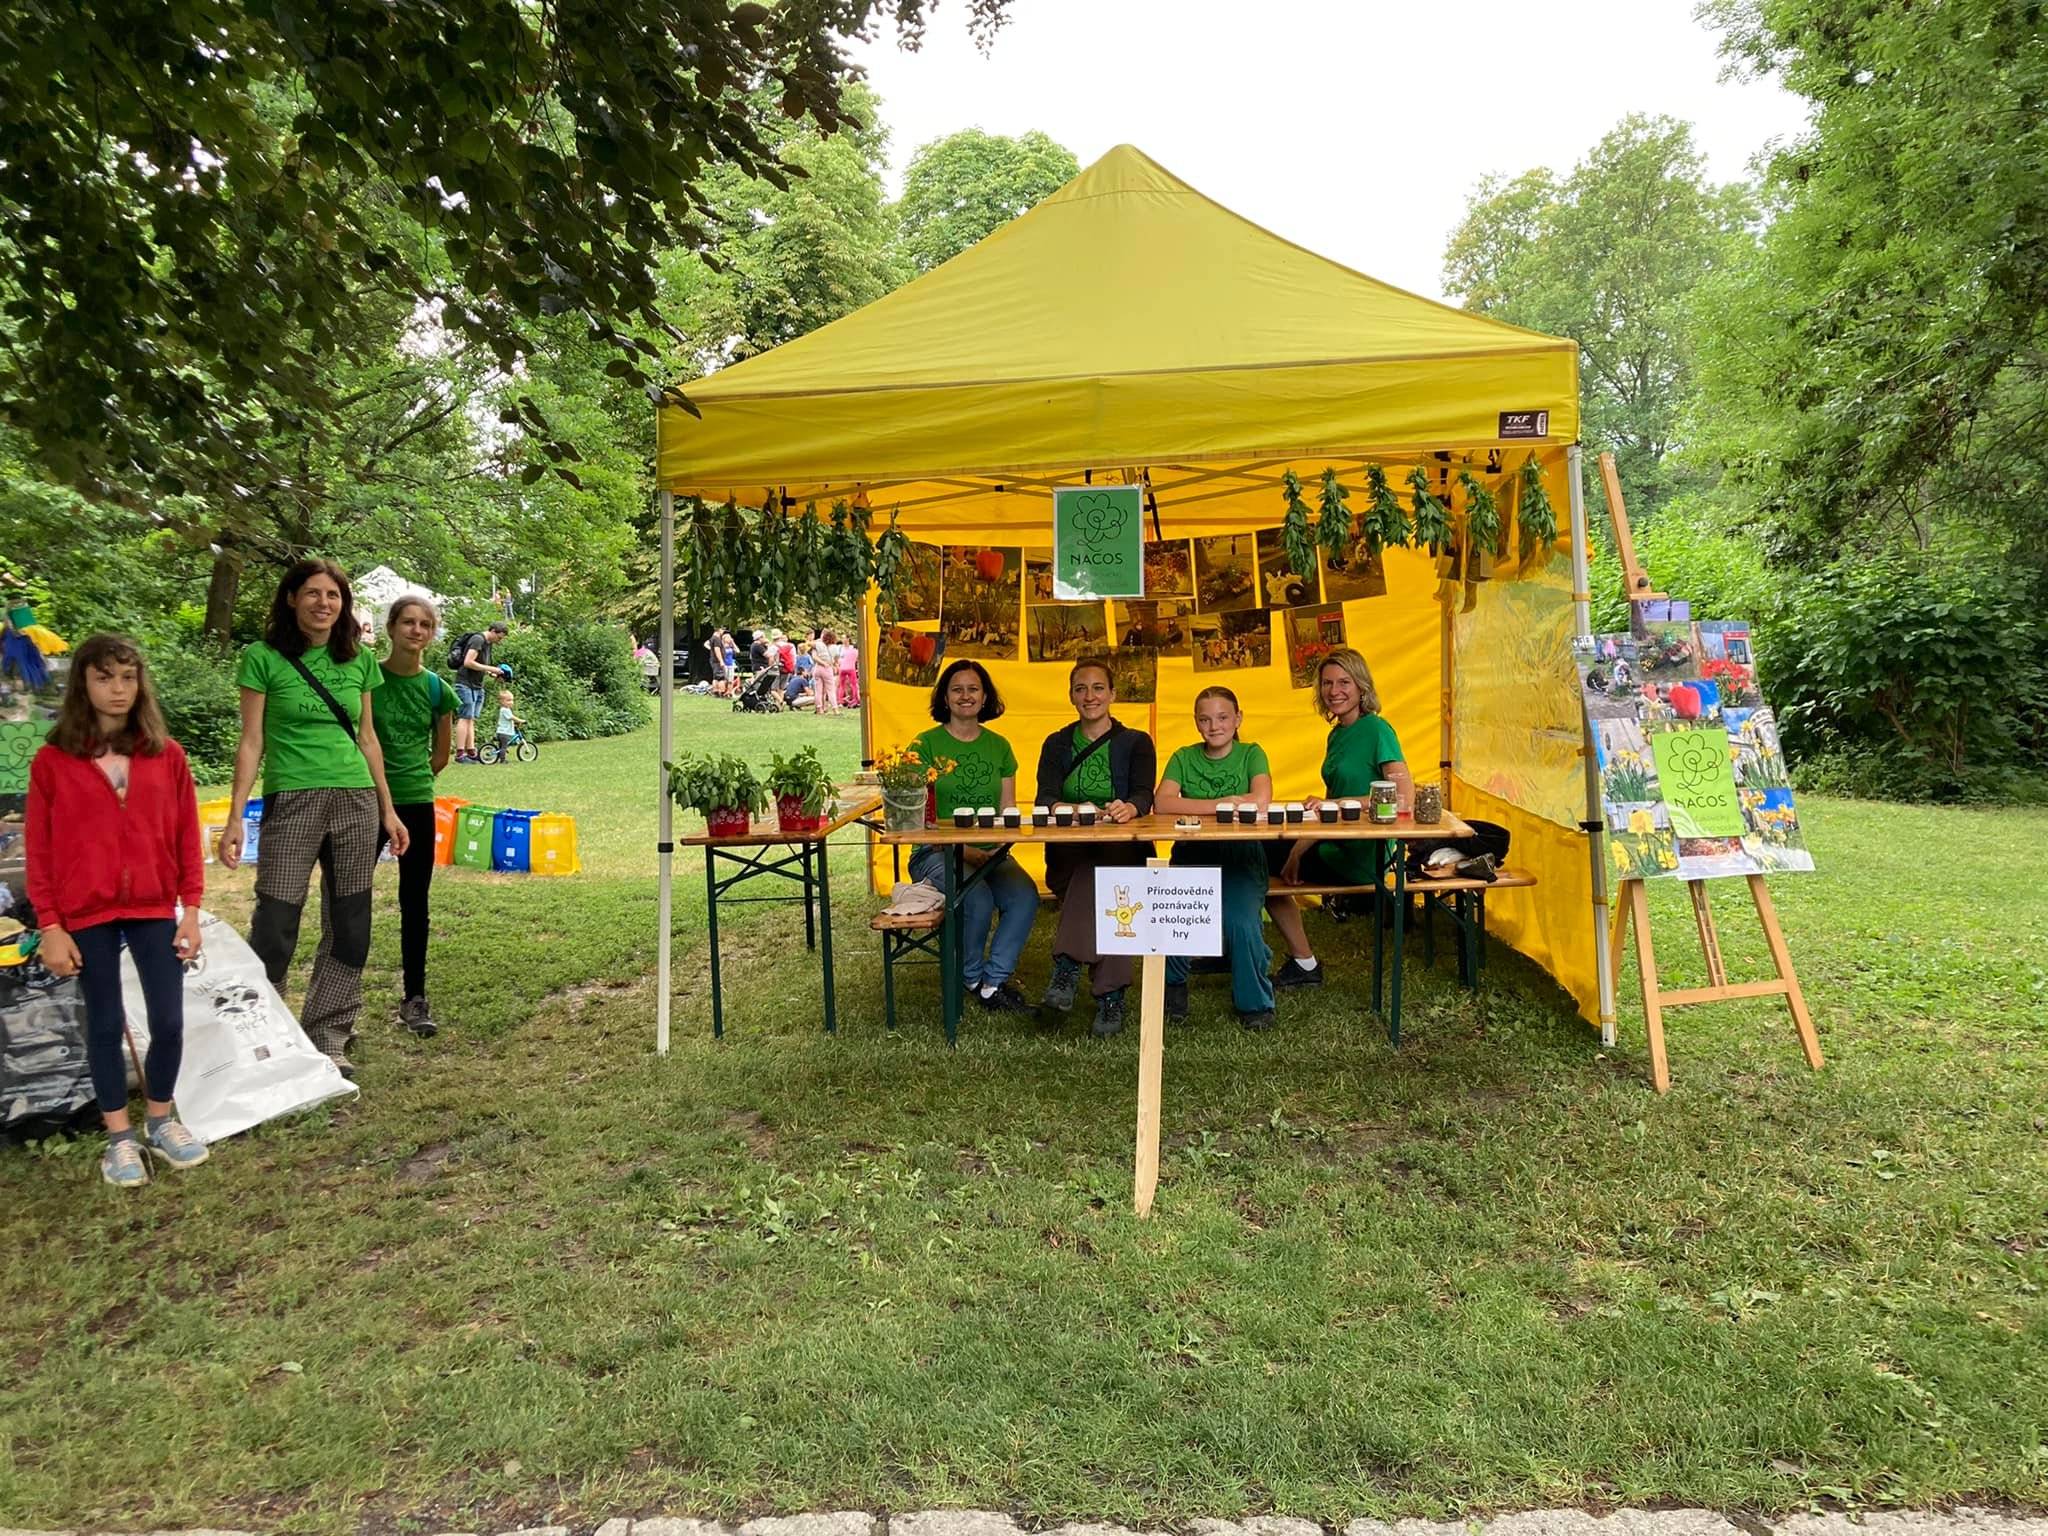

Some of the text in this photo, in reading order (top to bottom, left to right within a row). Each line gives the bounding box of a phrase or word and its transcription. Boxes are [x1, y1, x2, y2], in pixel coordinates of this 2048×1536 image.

[1507, 415, 1530, 423] TKF
[1070, 553, 1124, 565] NACOS
[950, 794, 993, 804] NACOS
[1674, 795, 1728, 808] NACOS
[1147, 886, 1214, 896] Přírodovědné
[1152, 901, 1210, 913] poznávačky
[1159, 914, 1212, 926] ekologické
[1172, 929, 1190, 940] hry
